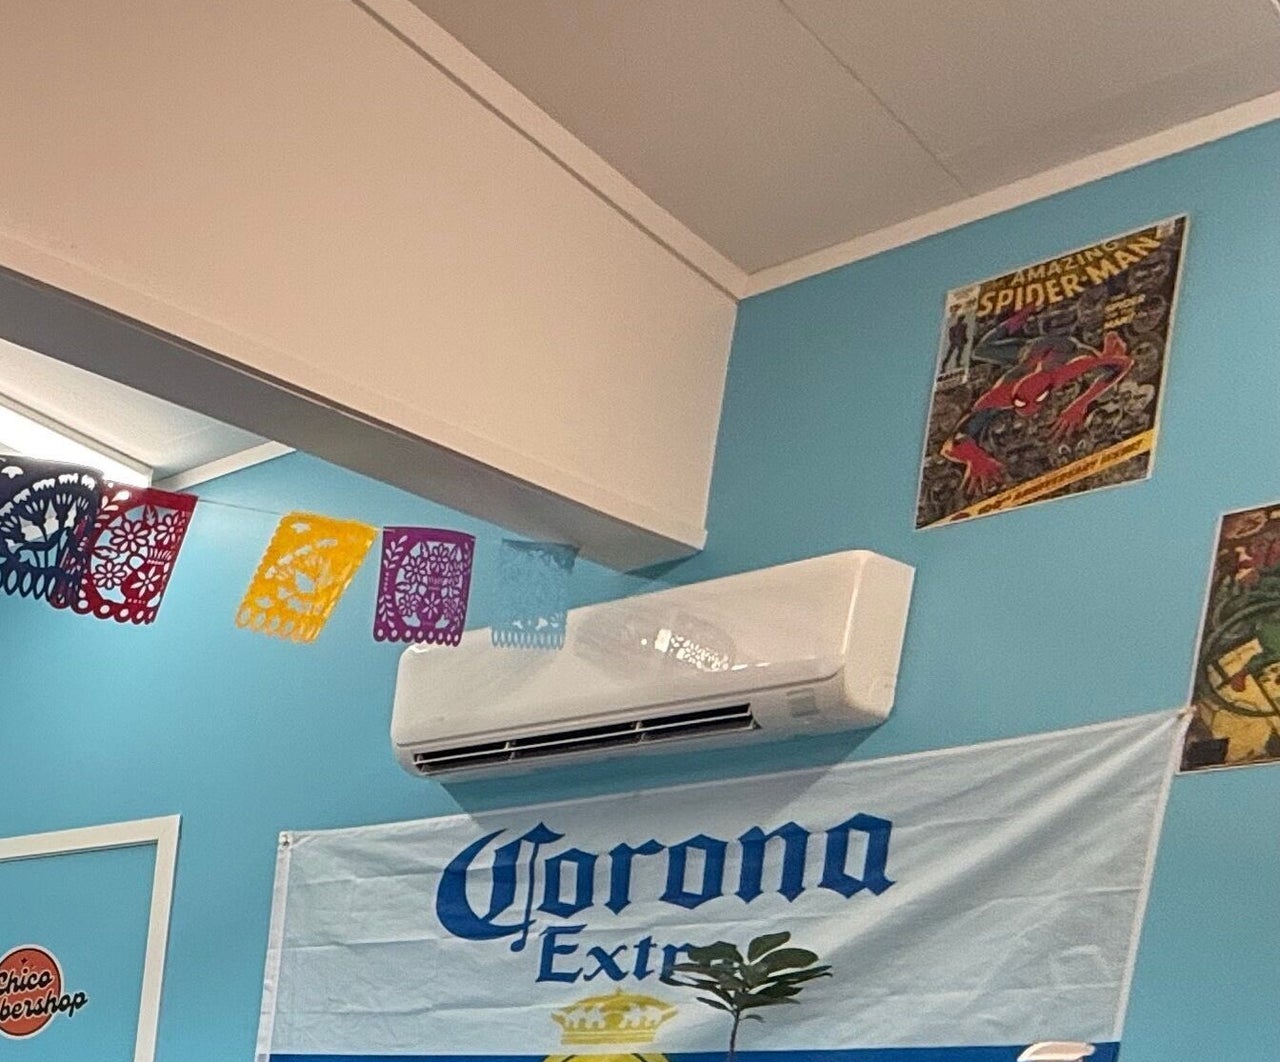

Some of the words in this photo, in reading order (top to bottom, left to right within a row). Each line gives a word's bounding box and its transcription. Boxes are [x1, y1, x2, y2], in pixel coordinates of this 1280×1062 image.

[976, 235, 1161, 317] SPIDER-MAN
[1010, 241, 1118, 286] AMAZING
[435, 811, 898, 952] Corona
[535, 923, 700, 985] Extr
